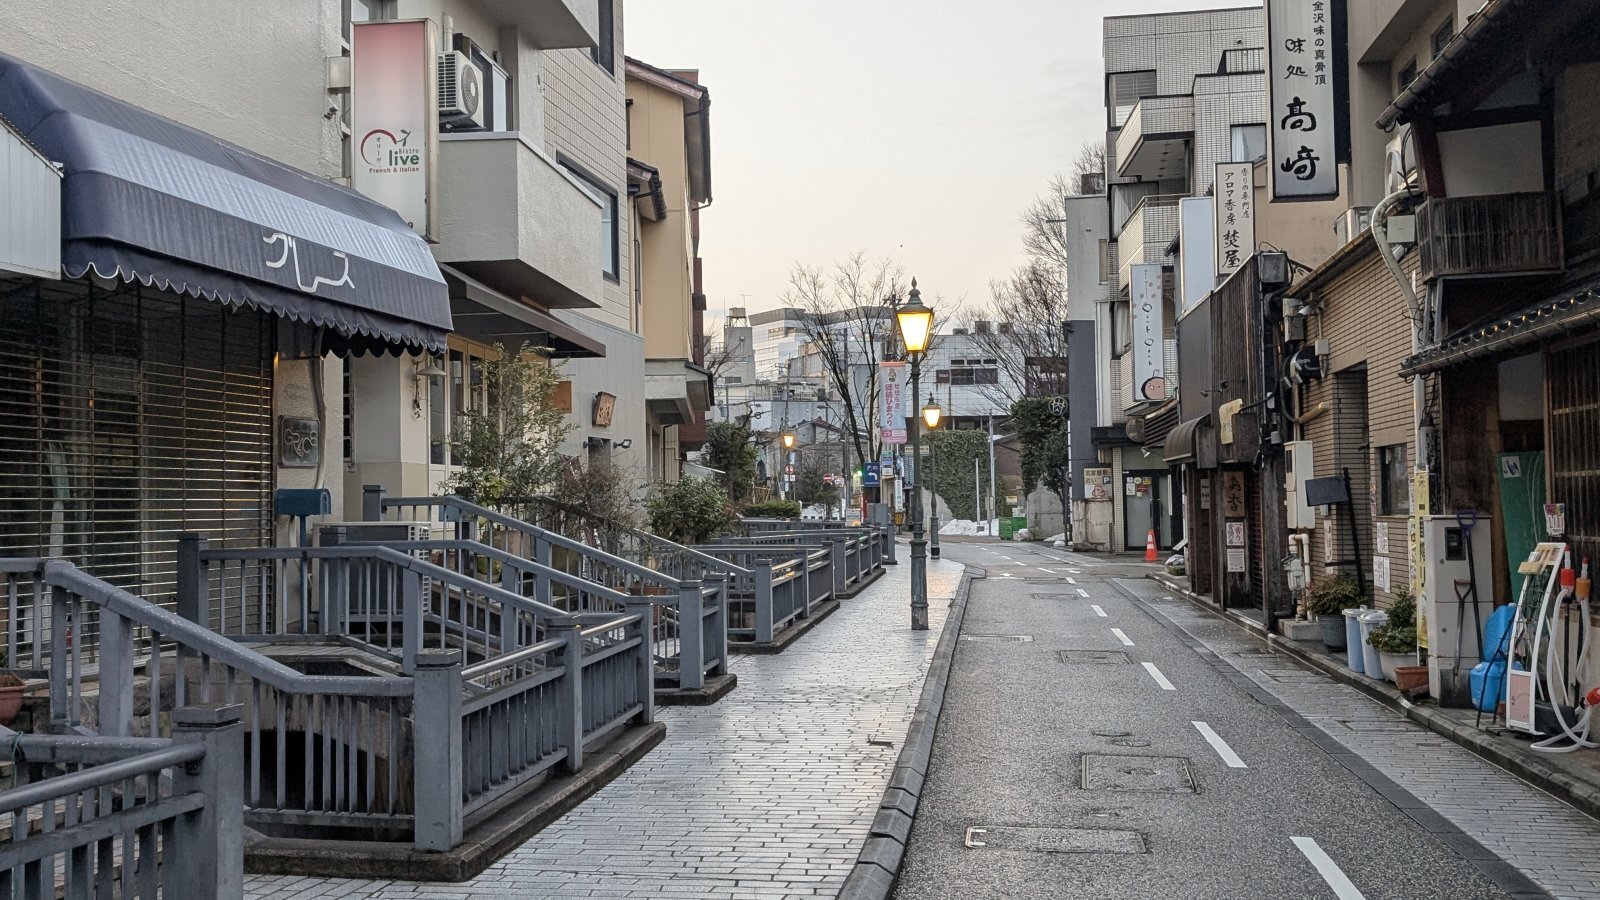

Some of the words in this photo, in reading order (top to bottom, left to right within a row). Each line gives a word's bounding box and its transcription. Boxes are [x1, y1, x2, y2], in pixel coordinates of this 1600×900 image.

[1284, 38, 1308, 79] 味処
[1312, 1, 1327, 85] 金沢味の真骨頂
[1224, 172, 1237, 226] アロマ香房
[262, 232, 355, 293] グレース
[1222, 229, 1241, 269] 焚屋
[1103, 476, 1110, 484] P
